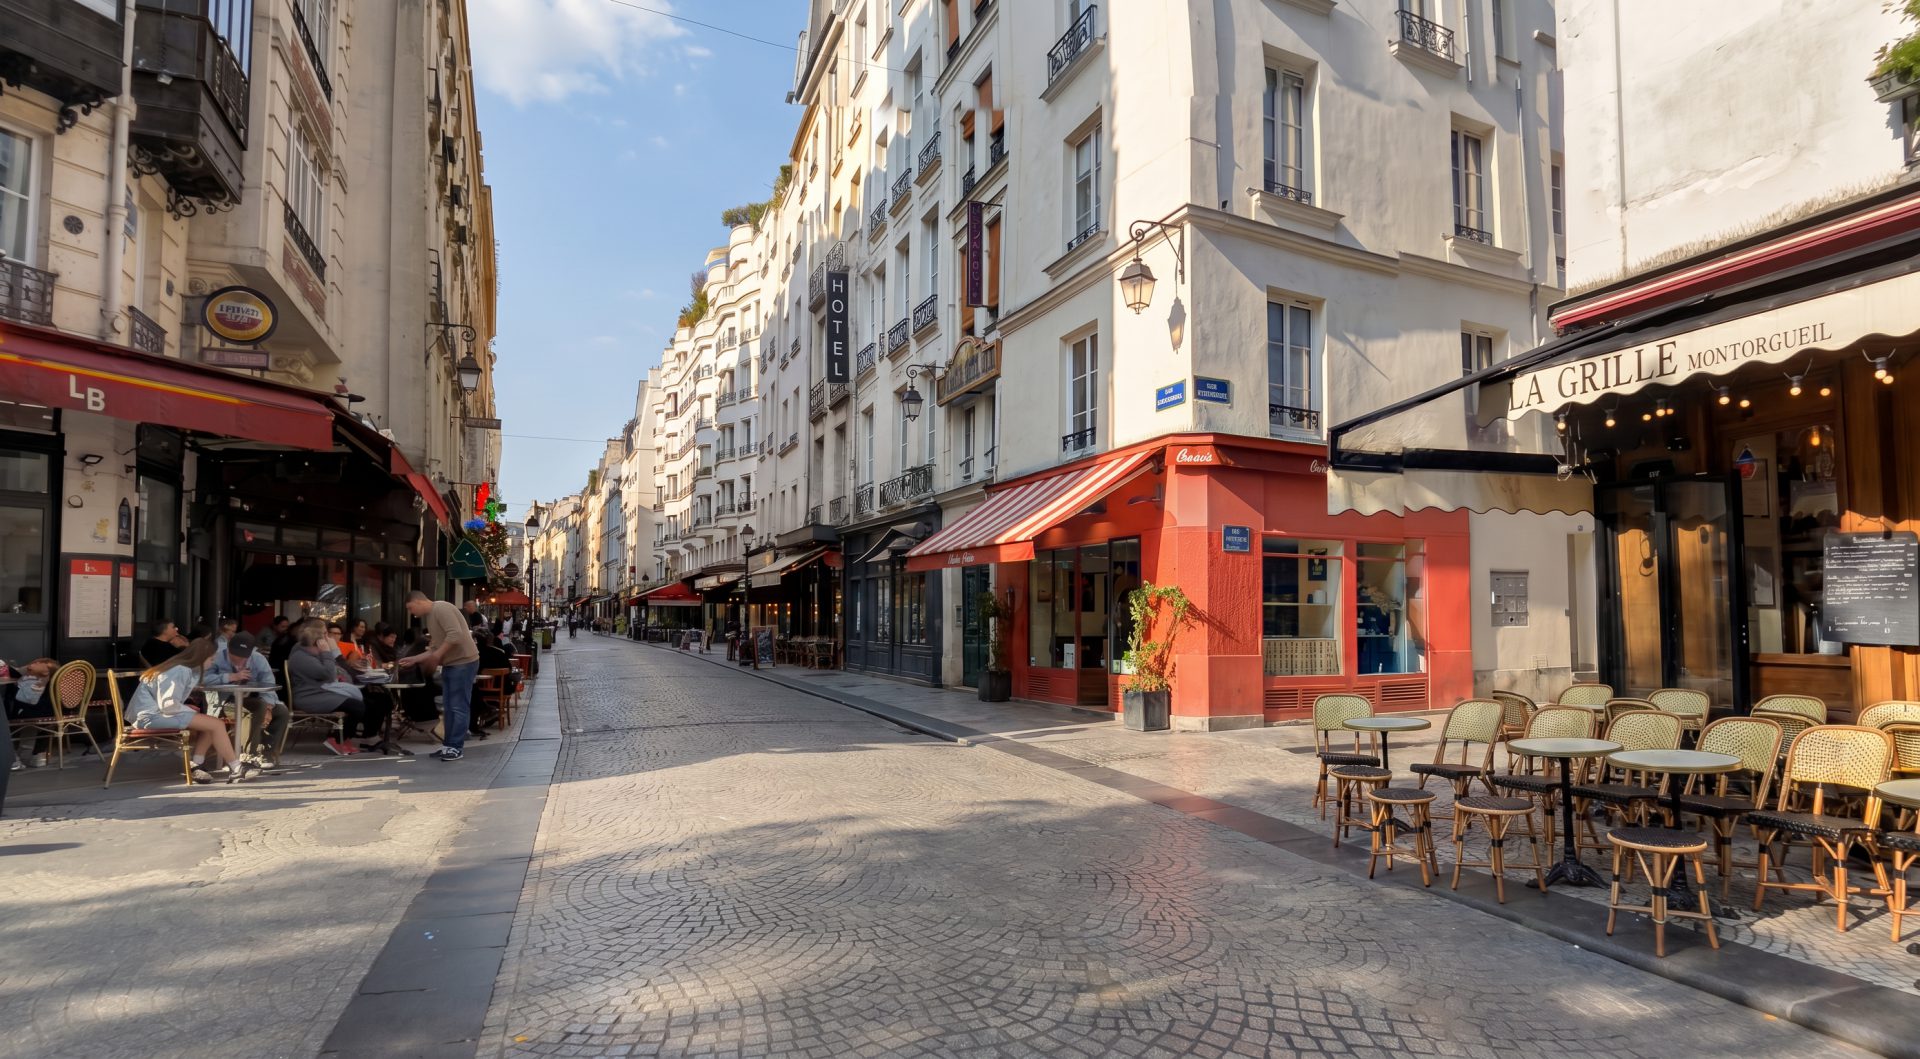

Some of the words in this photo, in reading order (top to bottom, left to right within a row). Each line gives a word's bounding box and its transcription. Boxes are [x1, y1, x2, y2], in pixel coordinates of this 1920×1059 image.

[832, 279, 844, 376] HOTEL
[1508, 373, 1545, 411] LA
[1558, 341, 1679, 399] GRILLE
[1687, 322, 1832, 372] MONTORGUEIL
